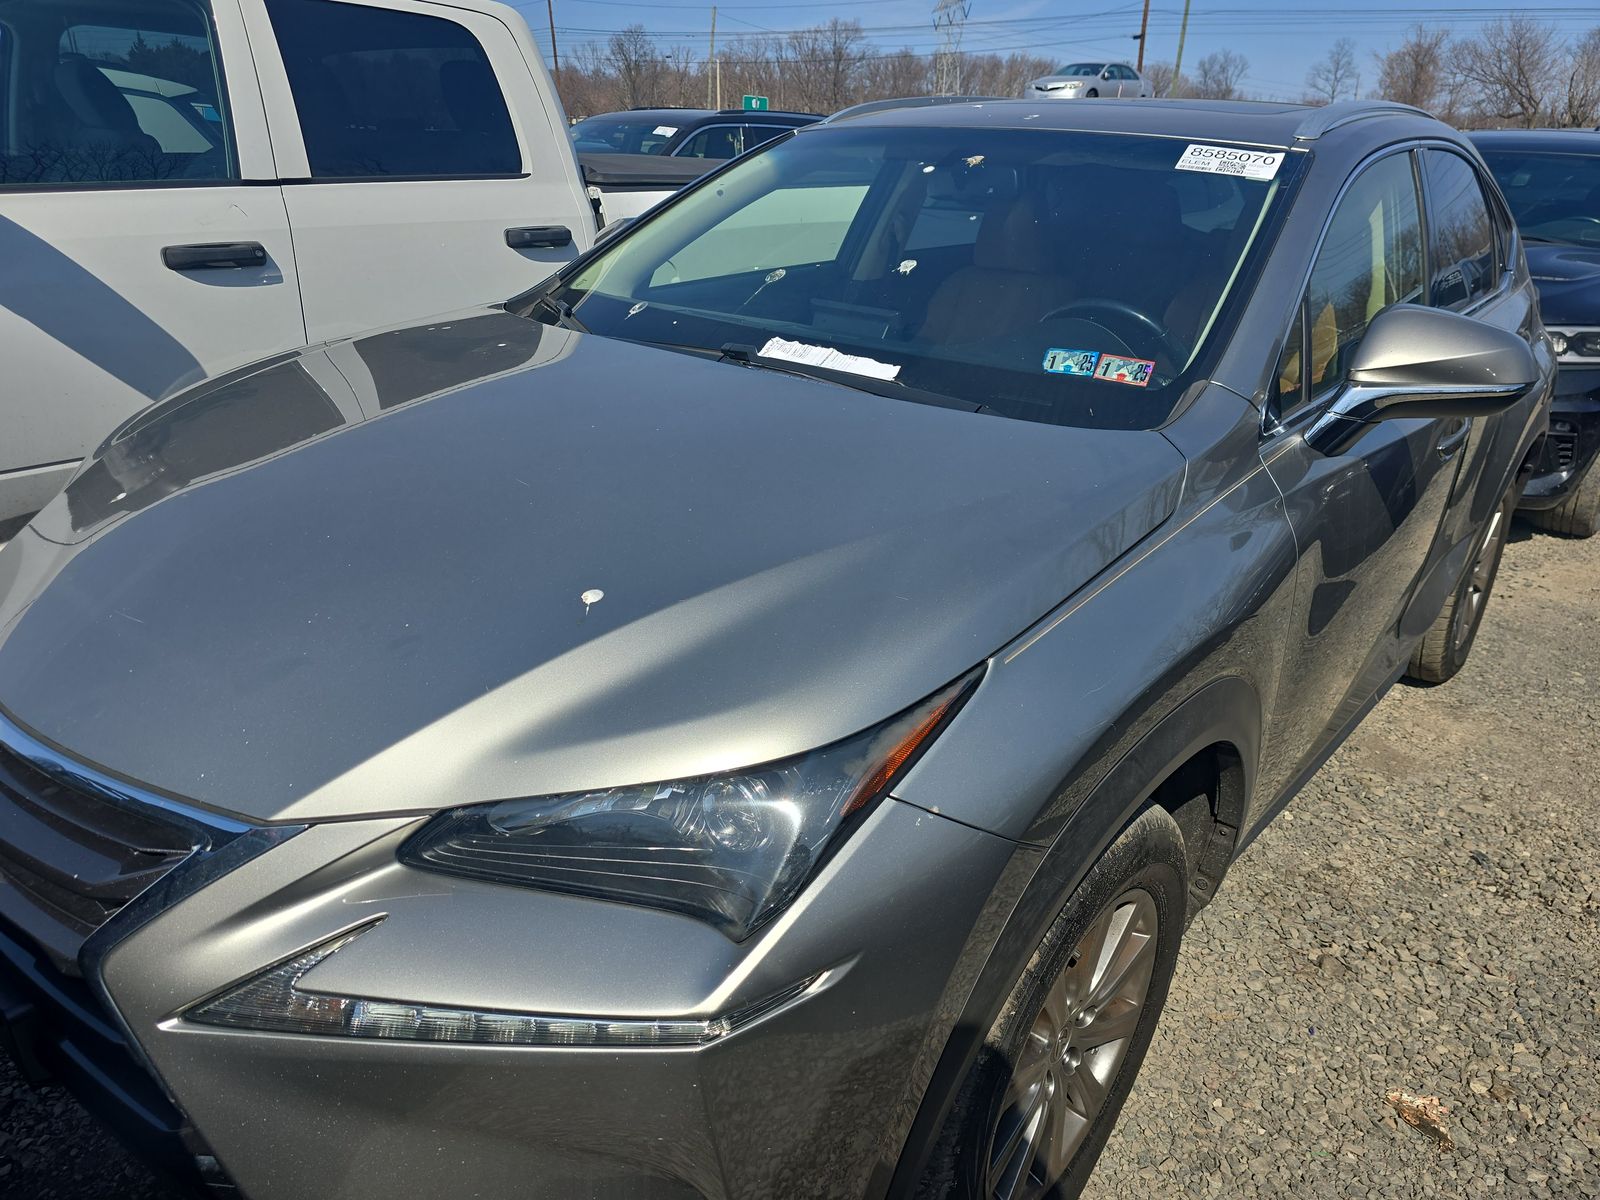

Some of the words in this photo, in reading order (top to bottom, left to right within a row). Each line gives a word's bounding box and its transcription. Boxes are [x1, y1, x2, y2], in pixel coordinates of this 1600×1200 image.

[1190, 147, 1276, 165] 8585070
[1050, 355, 1057, 369] 1
[1079, 354, 1095, 372] 25
[1102, 362, 1111, 376] 1
[1133, 363, 1151, 381] 25
